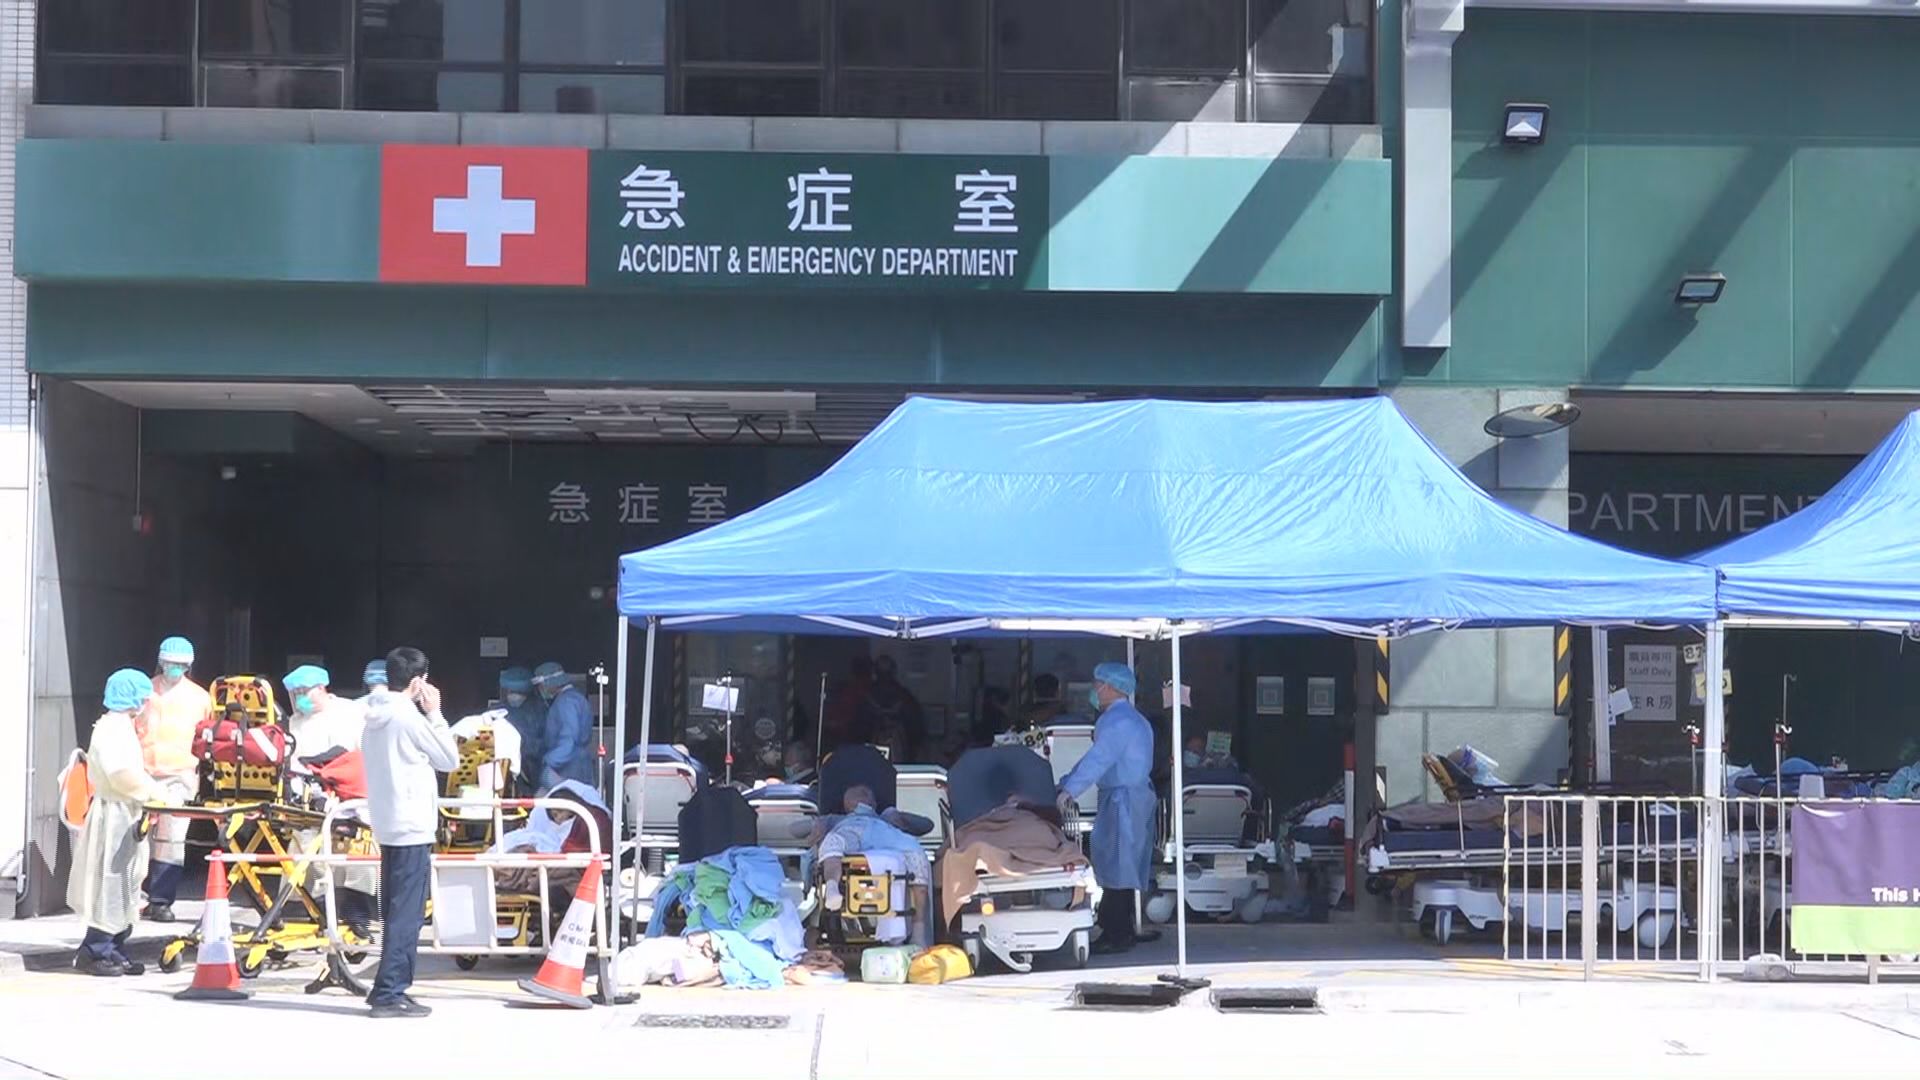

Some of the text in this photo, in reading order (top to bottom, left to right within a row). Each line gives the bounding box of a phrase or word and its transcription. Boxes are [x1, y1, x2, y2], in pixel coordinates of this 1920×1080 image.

[619, 164, 1018, 232] 急症室
[618, 244, 1018, 276] ACCIDENT & EMERGENCY DEPARTMENT
[549, 482, 728, 523] 急症室
[1872, 887, 1908, 902] This
